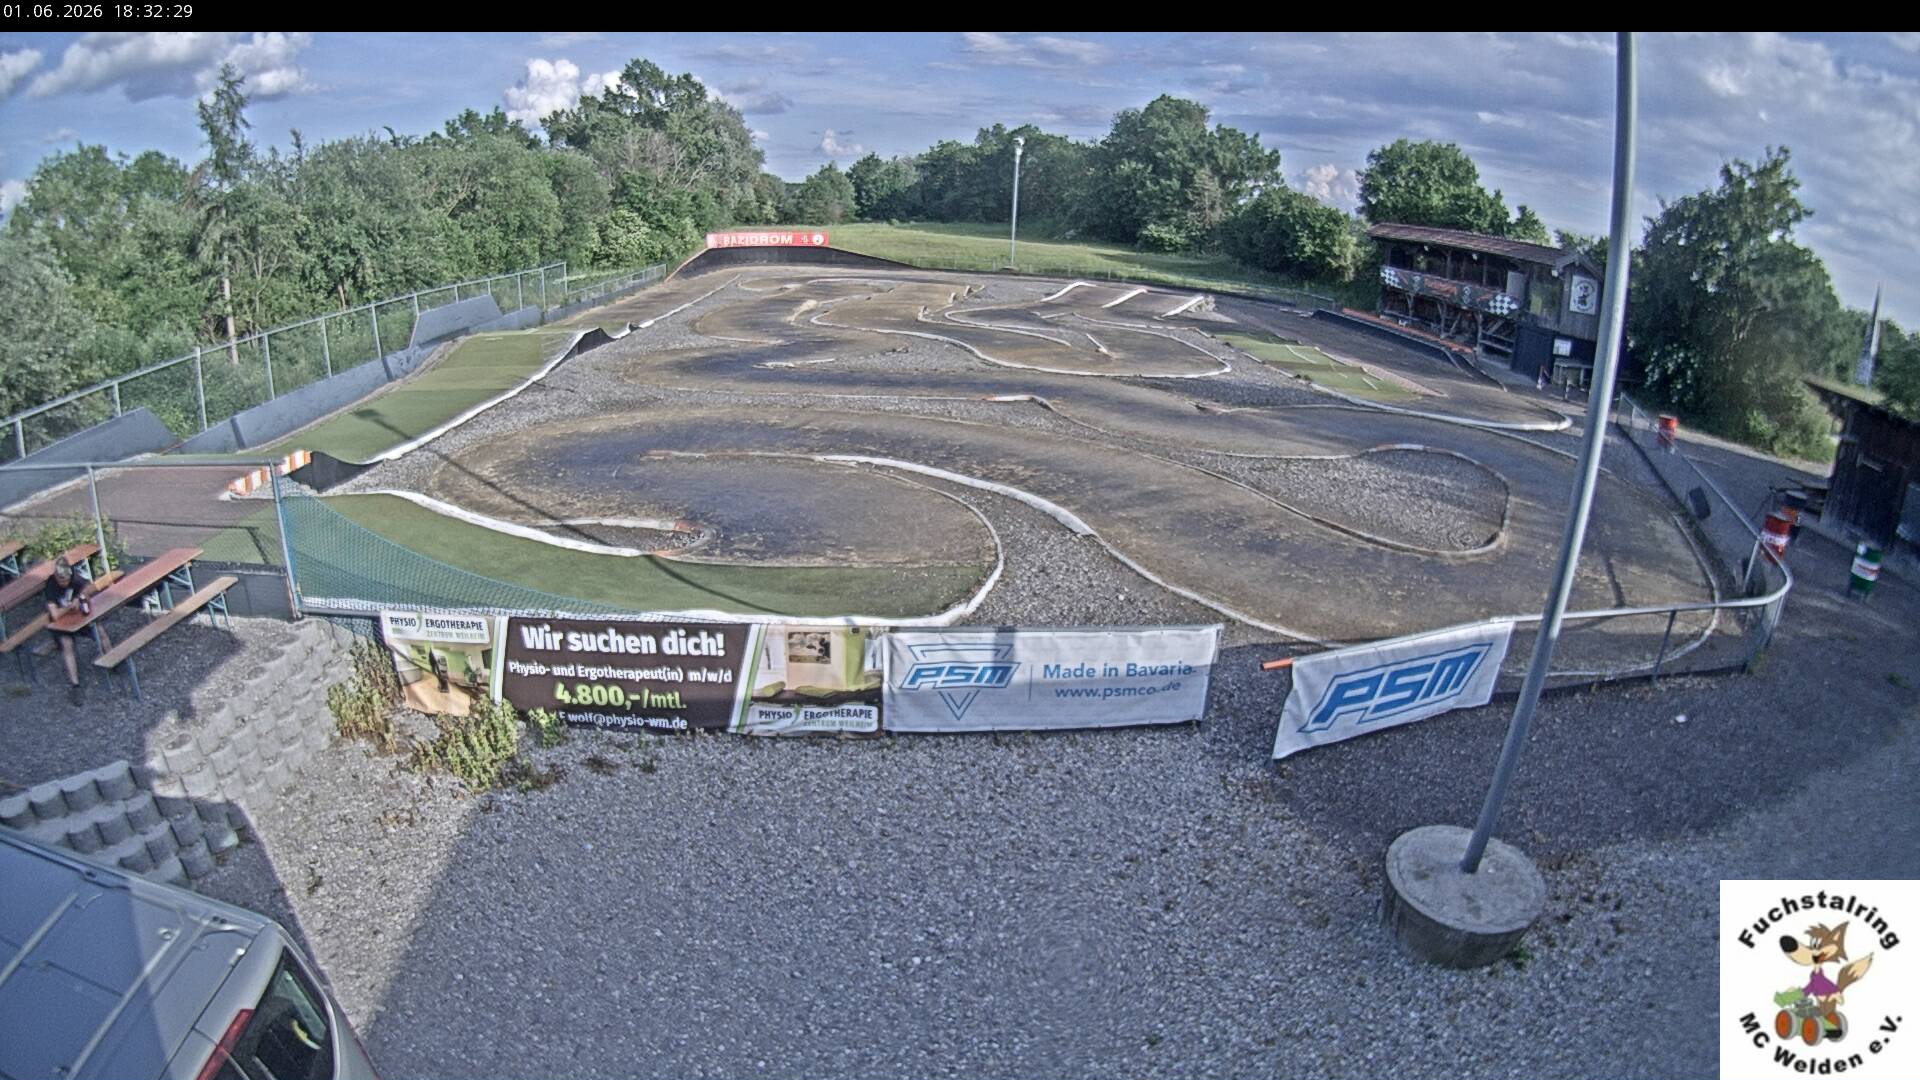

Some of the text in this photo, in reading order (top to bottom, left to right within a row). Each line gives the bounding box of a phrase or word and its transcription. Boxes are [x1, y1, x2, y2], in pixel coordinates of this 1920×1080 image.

[389, 616, 484, 631] PHYSIO ERGOTHERAPIE
[521, 623, 726, 657] Wir suchen dich!
[508, 660, 733, 684] Physio- und Ergotherapeut(in) m/w/d
[904, 664, 1012, 688] PSM
[1042, 662, 1097, 679] Made
[1102, 663, 1119, 677] in
[1055, 681, 1181, 700] www.psmco.de
[1309, 649, 1484, 725] PSM
[567, 711, 688, 730] wolf@physio-wm.de
[759, 709, 873, 720] PHYSIO ERGOTHERAPIE
